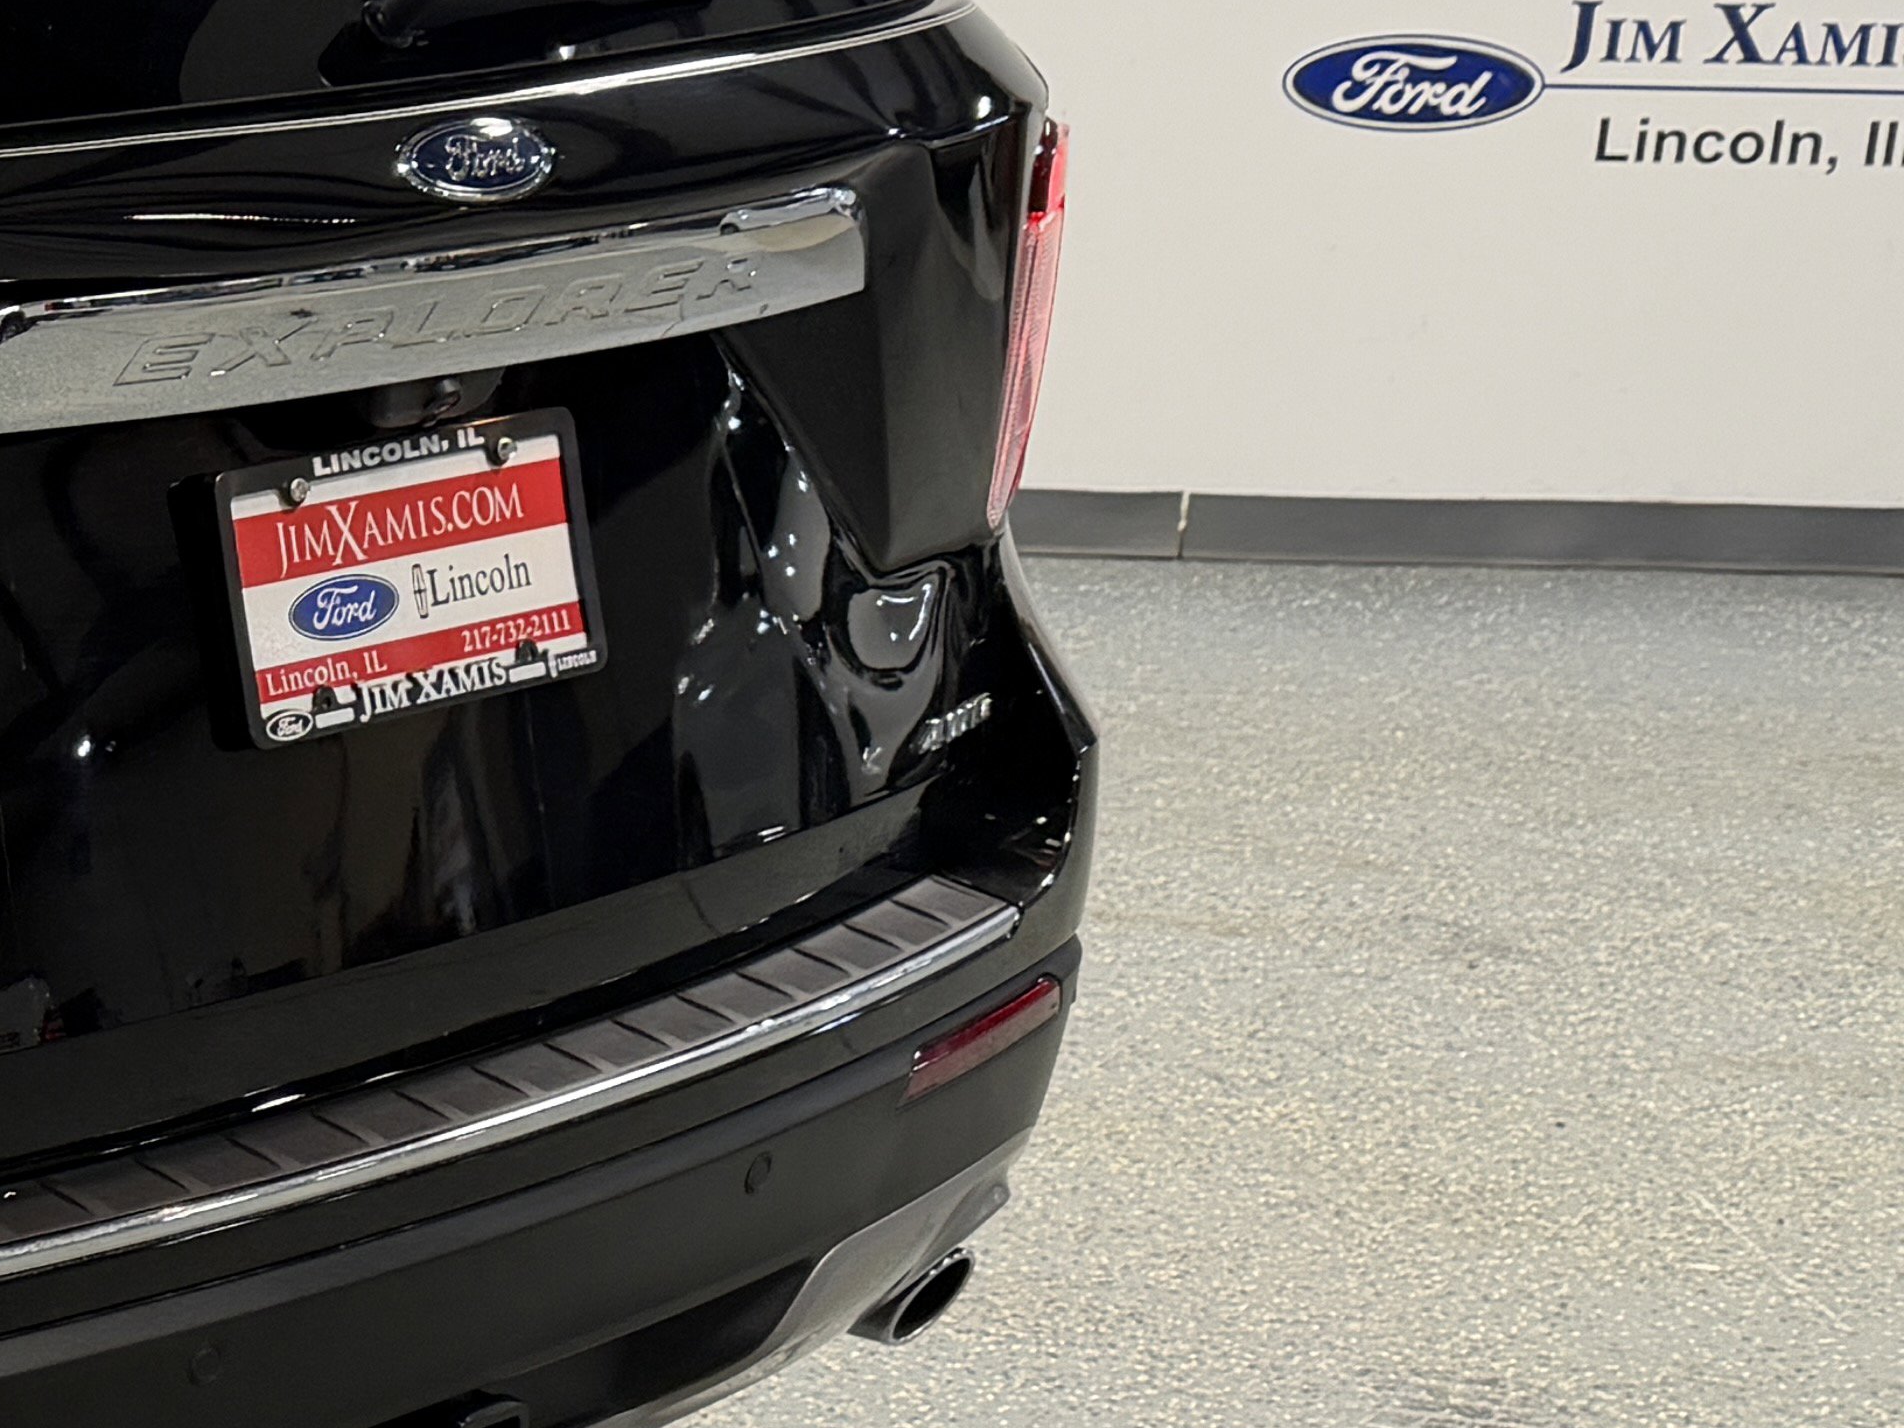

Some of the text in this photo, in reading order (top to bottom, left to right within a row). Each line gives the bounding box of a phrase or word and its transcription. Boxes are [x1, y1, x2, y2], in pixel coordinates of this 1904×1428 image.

[1703, 2, 1904, 68] XAMI
[1594, 117, 1838, 175] Lincoln,
[114, 251, 764, 388] EXPLORER
[312, 427, 485, 477] LINCOLN, IL
[427, 553, 532, 607] Lincoln
[265, 651, 388, 697] Lincoln, IL
